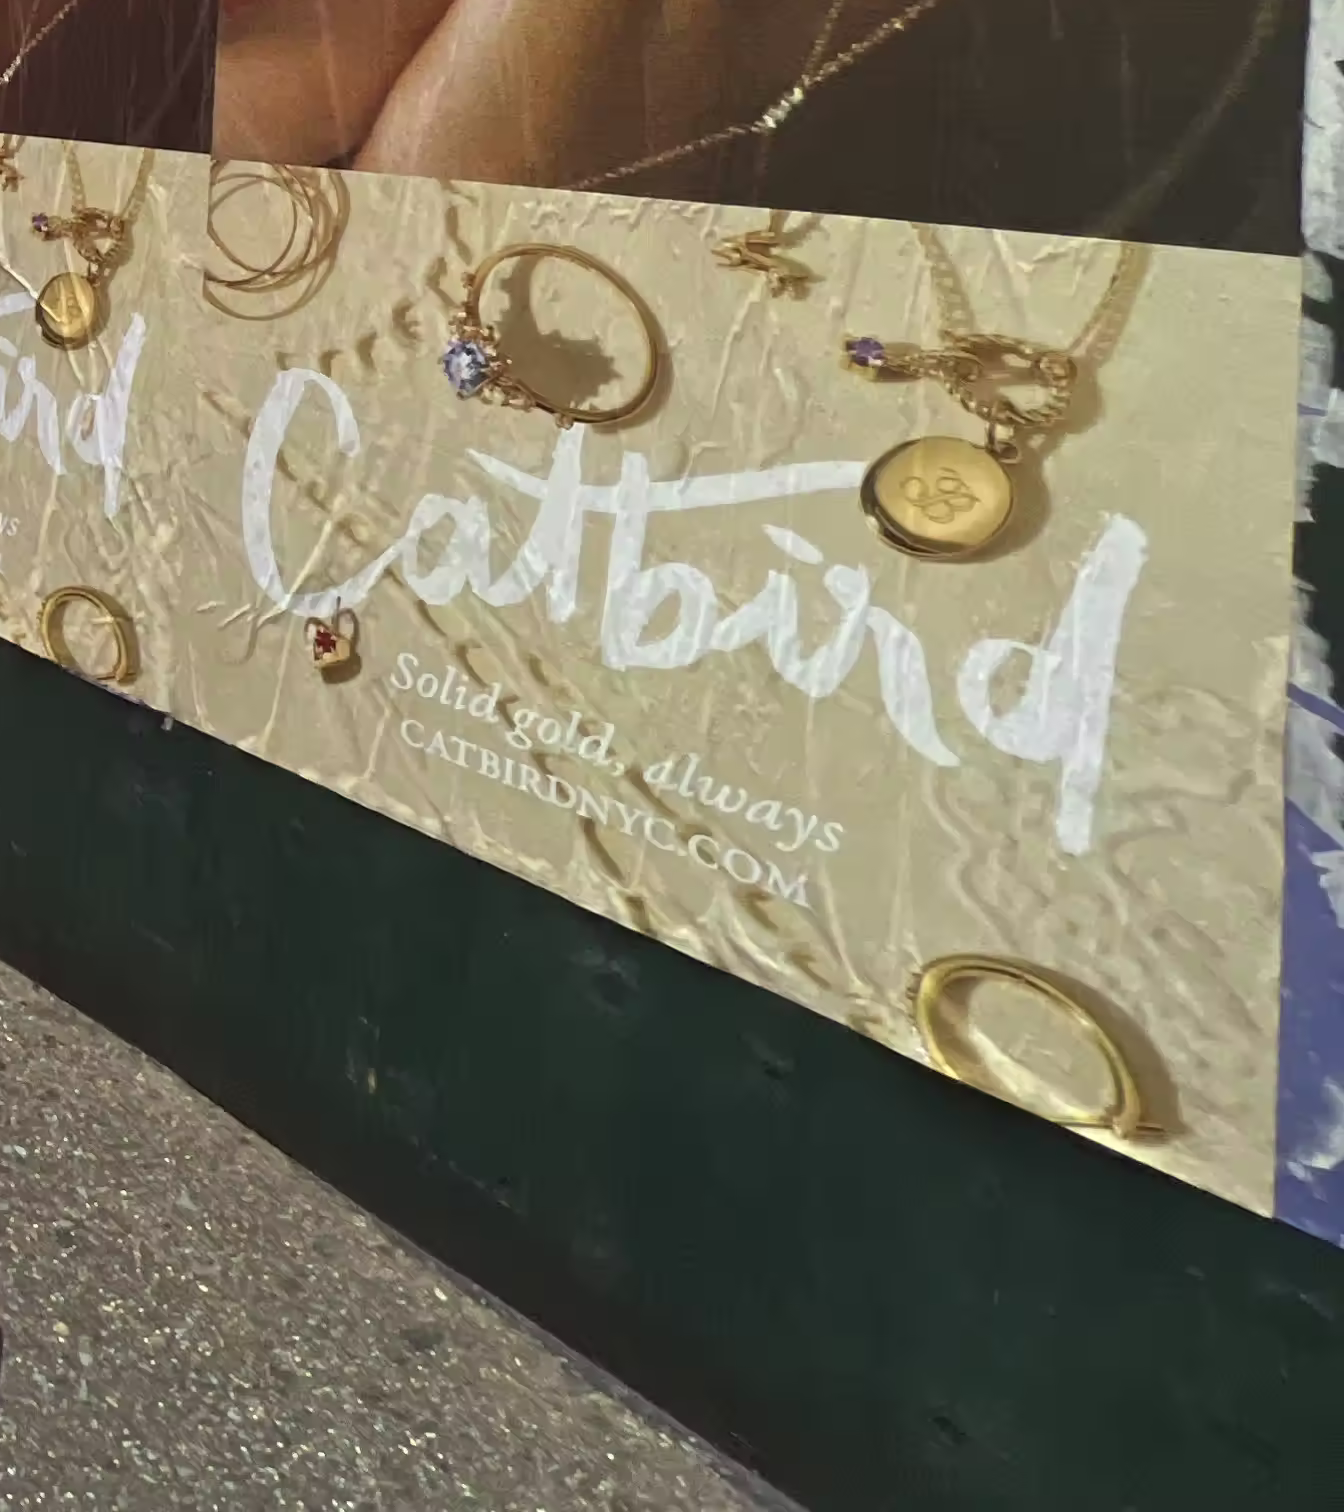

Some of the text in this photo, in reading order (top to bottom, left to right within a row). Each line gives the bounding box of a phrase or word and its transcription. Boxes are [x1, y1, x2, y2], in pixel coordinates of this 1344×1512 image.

[242, 368, 1148, 855] Catbird
[390, 652, 846, 854] Solid gold, always
[399, 718, 810, 908] CATBIRDNYC.COM
